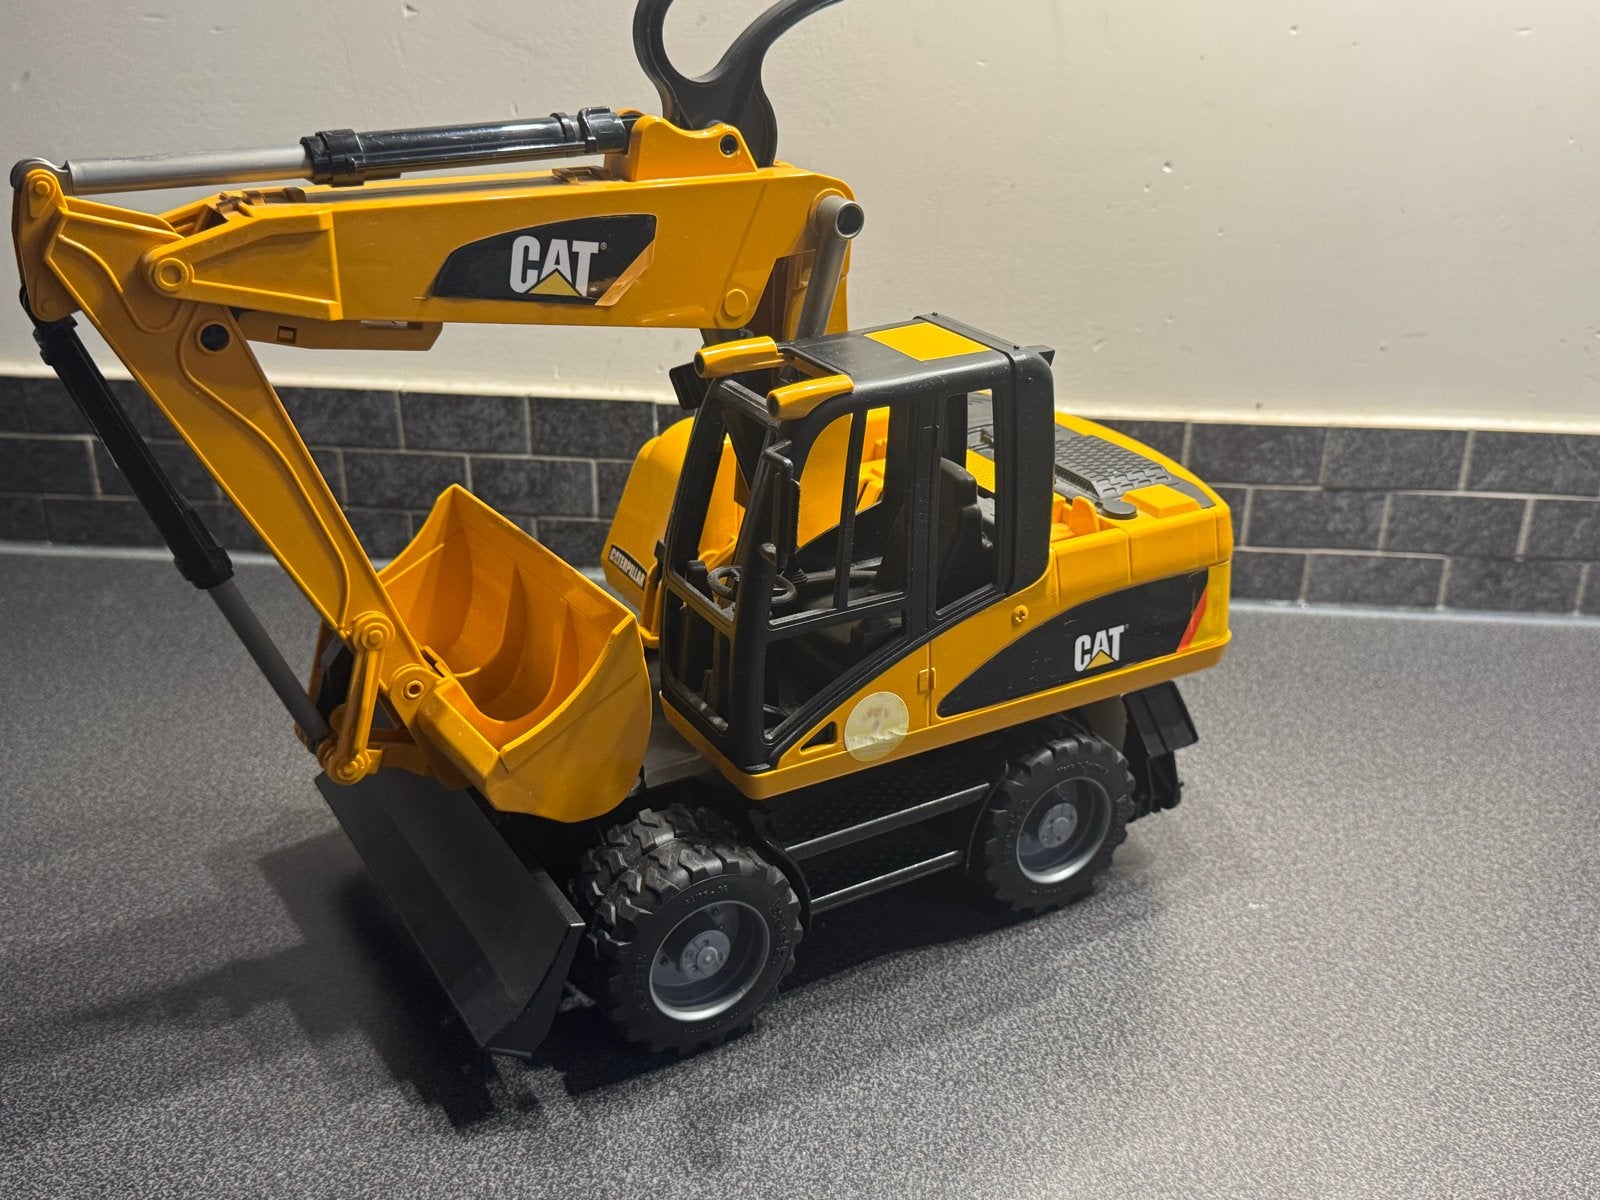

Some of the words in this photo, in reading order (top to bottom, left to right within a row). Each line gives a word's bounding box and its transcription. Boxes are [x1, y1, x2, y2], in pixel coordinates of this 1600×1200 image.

[510, 235, 599, 297] CAT
[610, 547, 646, 588] CATERPILLAR
[1074, 624, 1125, 672] CAT
